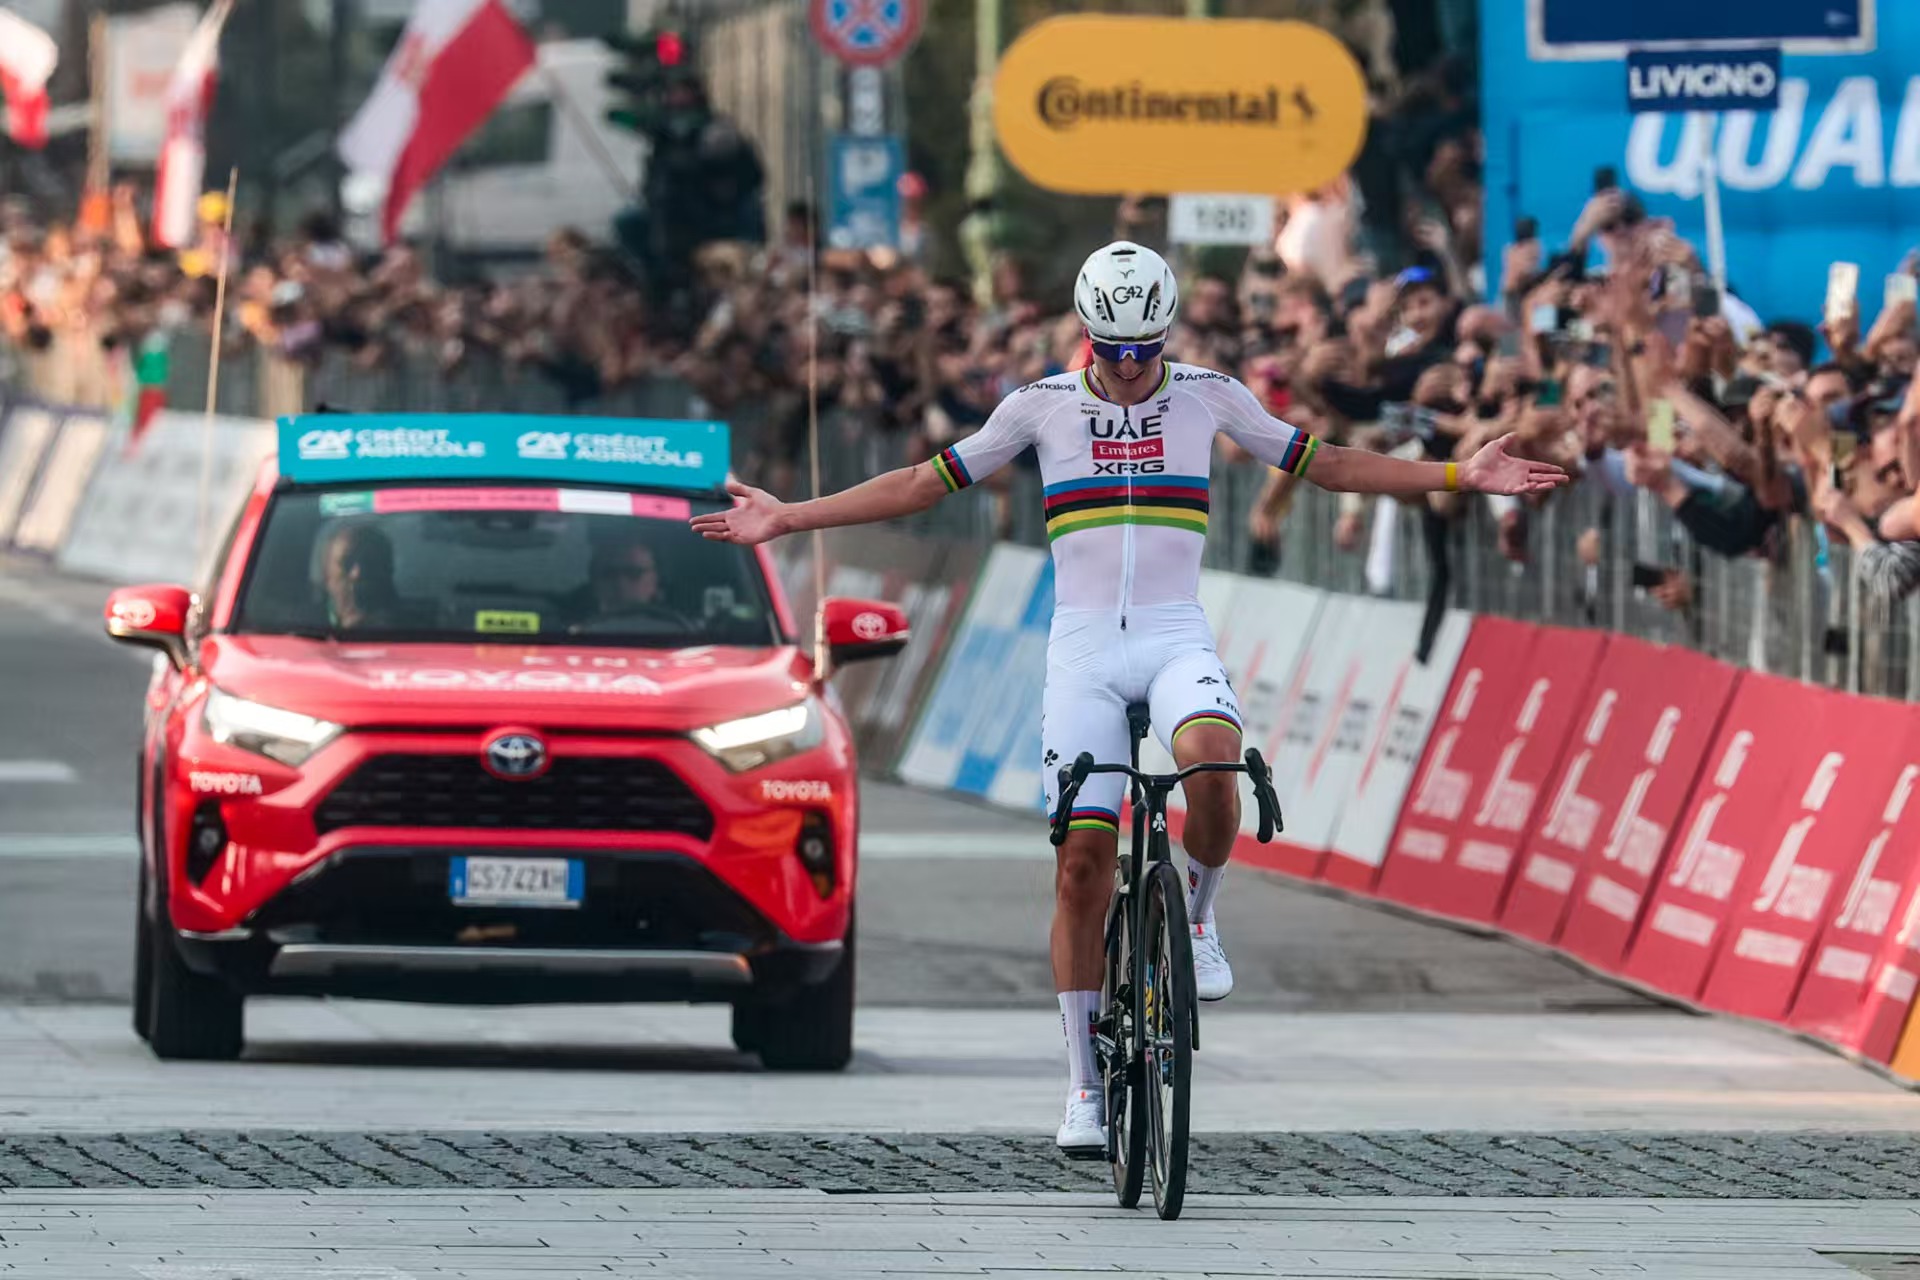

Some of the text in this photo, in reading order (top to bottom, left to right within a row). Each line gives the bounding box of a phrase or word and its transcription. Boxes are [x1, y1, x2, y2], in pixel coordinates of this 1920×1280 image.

[1629, 62, 1776, 98] LIVIGNO
[1036, 76, 1278, 131] Continental
[1112, 285, 1144, 305] G42
[1030, 383, 1076, 392] Analog
[1185, 372, 1230, 383] Analog
[1090, 414, 1163, 439] UAE
[356, 441, 486, 457] AGRICOLE
[574, 447, 704, 468] AGRICOLE
[1093, 460, 1165, 475] XRG
[369, 668, 662, 695] TOYOTA
[190, 771, 262, 794] TOYOTA
[761, 780, 832, 801] TOYOTA
